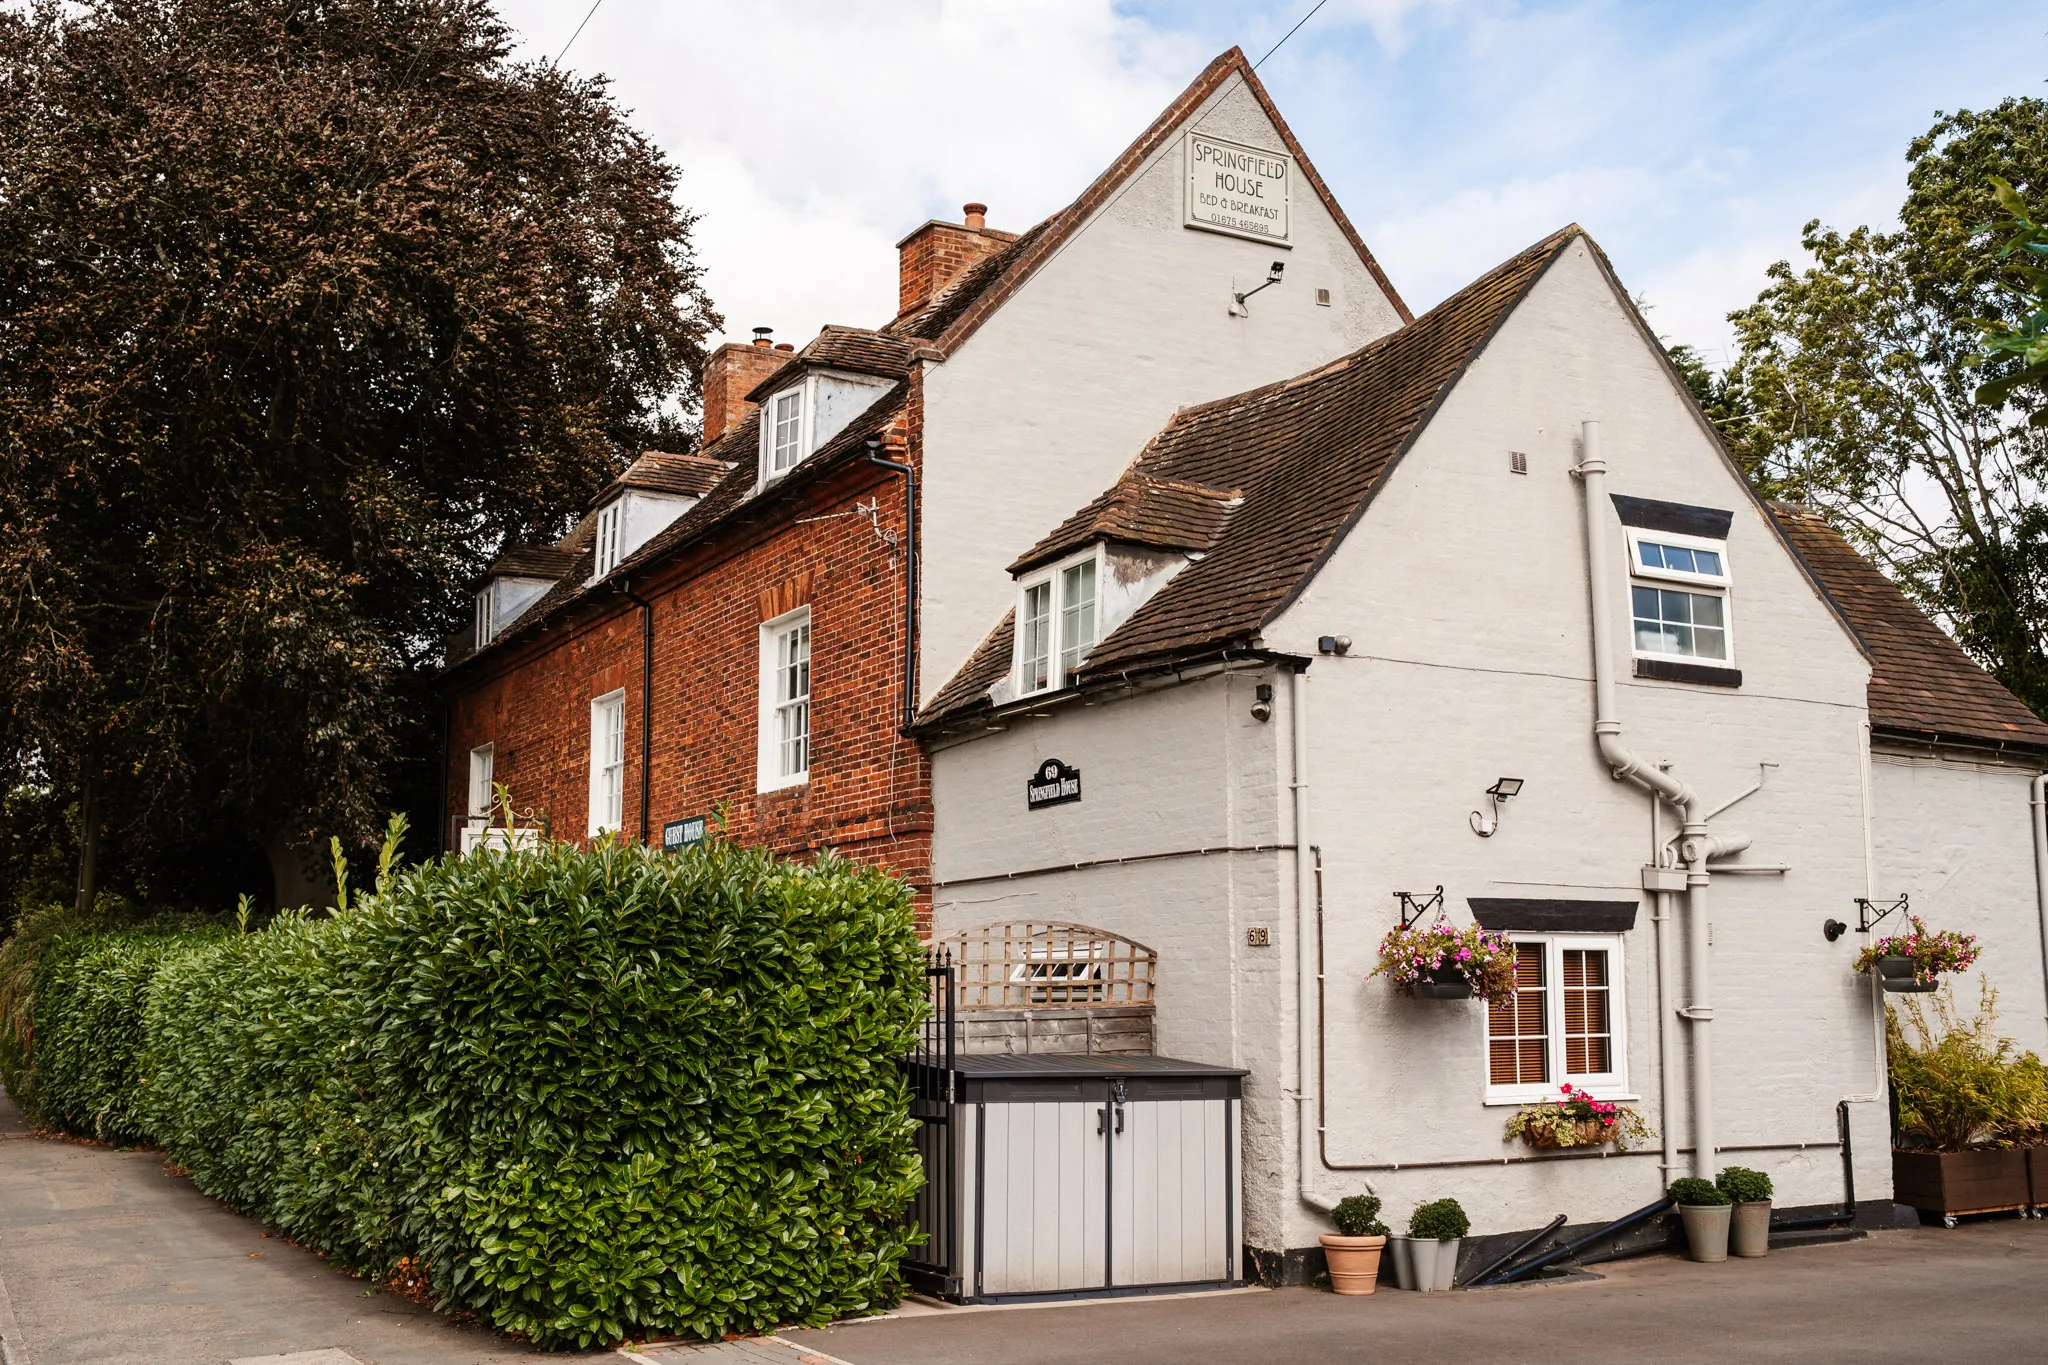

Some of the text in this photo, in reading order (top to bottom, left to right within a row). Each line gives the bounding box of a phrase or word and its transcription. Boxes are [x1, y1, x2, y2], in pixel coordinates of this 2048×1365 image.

[1195, 144, 1284, 180] SPRINGFIELD
[1215, 171, 1264, 199] HOUSE
[1199, 192, 1279, 221] BED & BREAKFAST
[1211, 212, 1237, 226] 01675
[1045, 764, 1058, 780] 69
[665, 824, 684, 846] GUEST
[1249, 929, 1266, 943] 69
